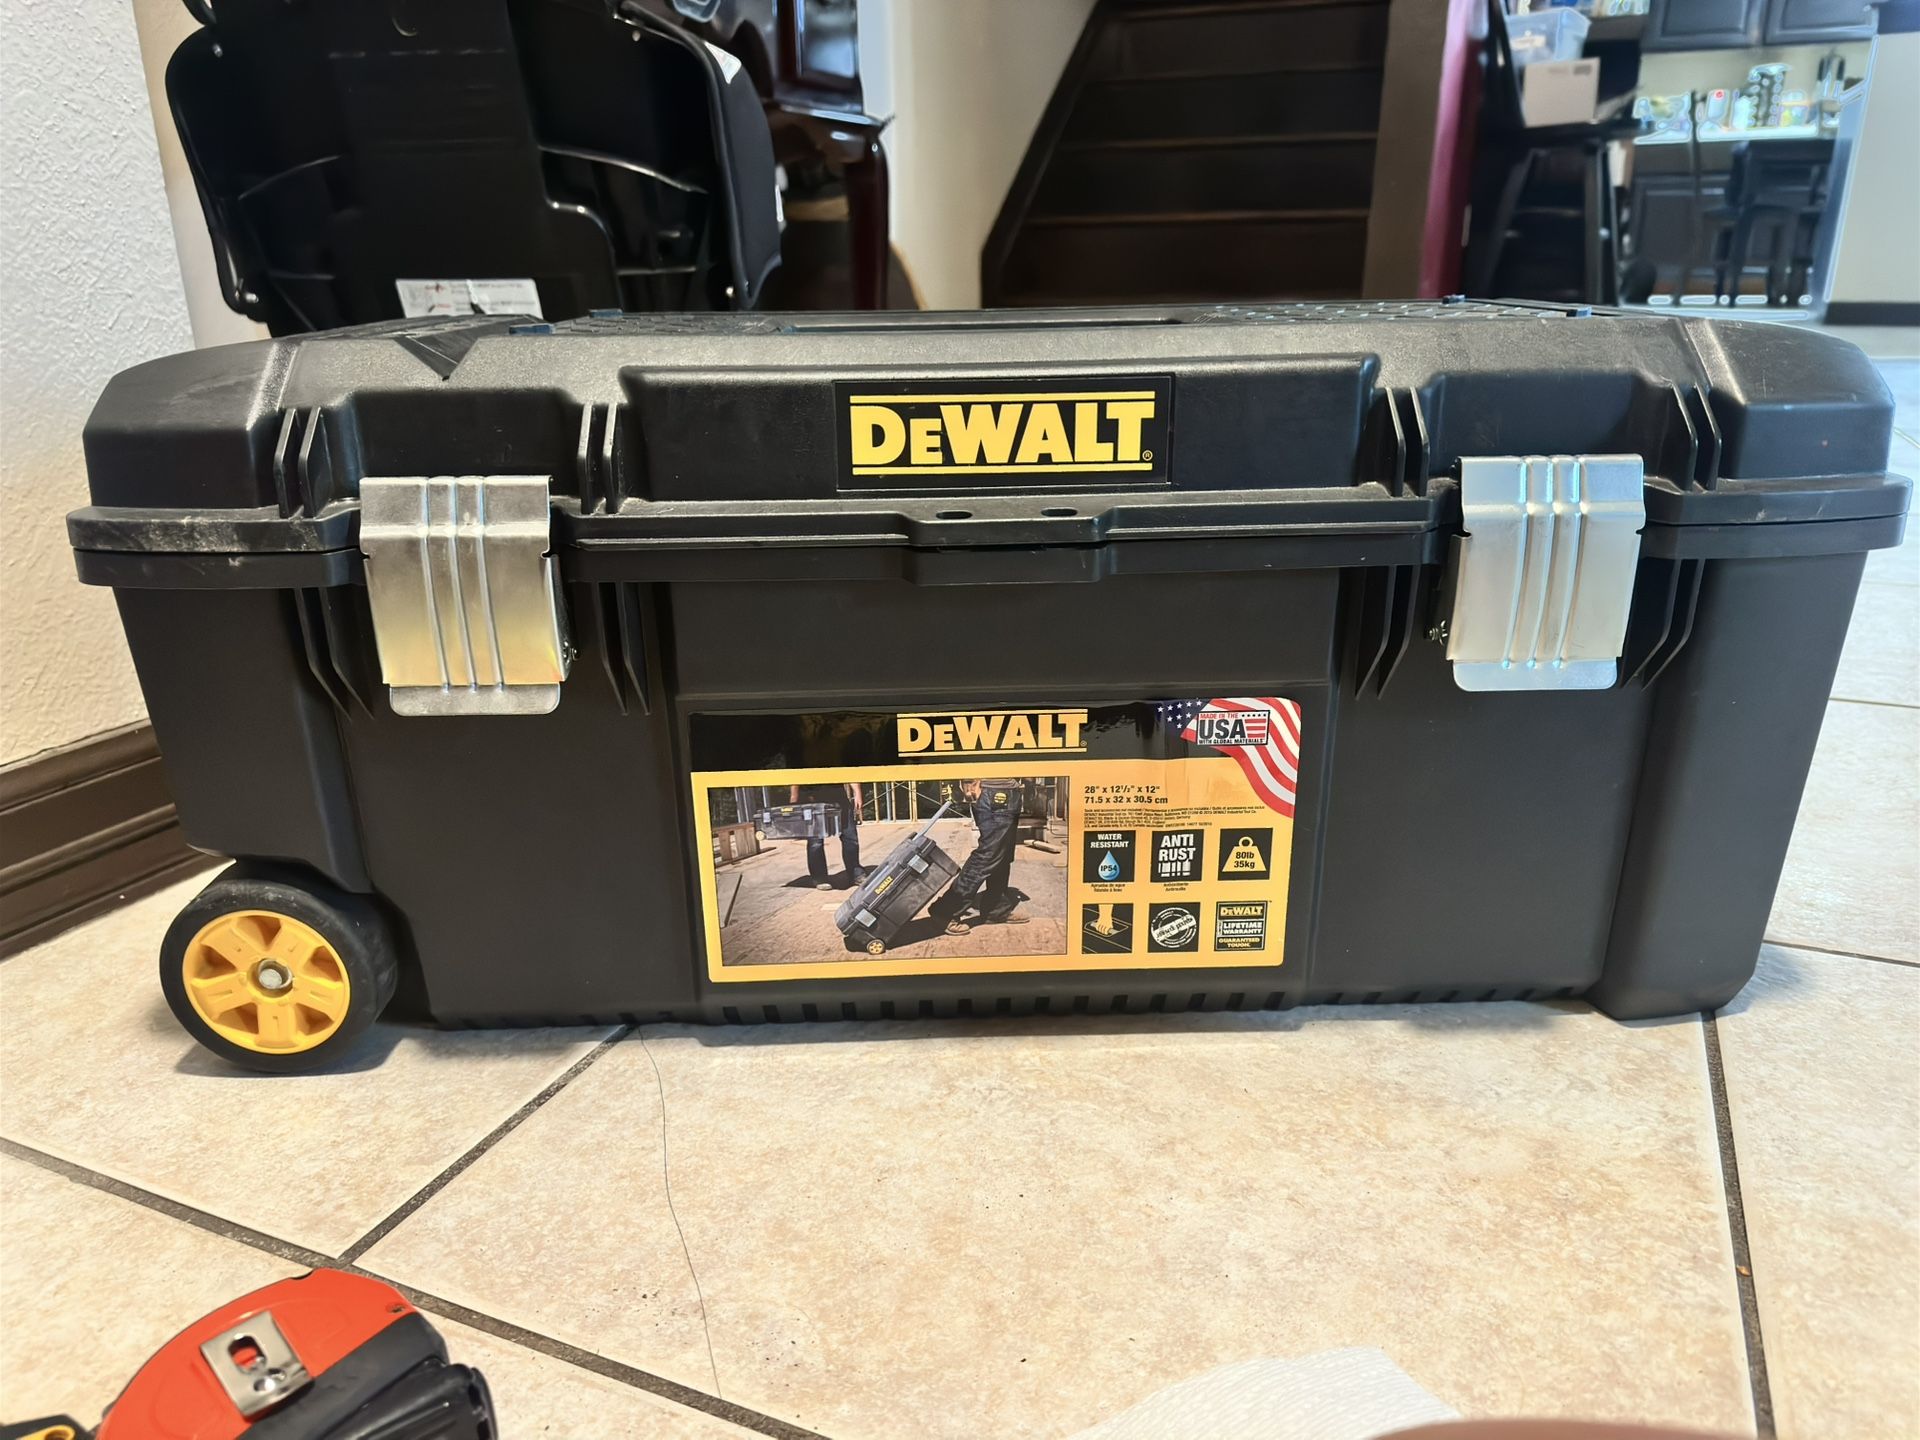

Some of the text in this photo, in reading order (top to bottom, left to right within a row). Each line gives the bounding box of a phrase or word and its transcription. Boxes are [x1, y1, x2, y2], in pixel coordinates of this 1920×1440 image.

[850, 401, 1155, 465] DEWALT
[897, 713, 1088, 753] DEWALT
[1199, 718, 1246, 740] USA
[1084, 796, 1103, 804] 71.5
[1133, 795, 1153, 804] 30.5
[1097, 833, 1122, 841] WATER
[1160, 833, 1194, 848] ANTI
[1159, 847, 1196, 862] RUST
[1235, 851, 1255, 859] 80lb
[1100, 864, 1117, 872] IP54
[1233, 861, 1255, 869] 35kg
[1220, 906, 1263, 916] DEWALT
[1223, 921, 1263, 929] LIFETIME
